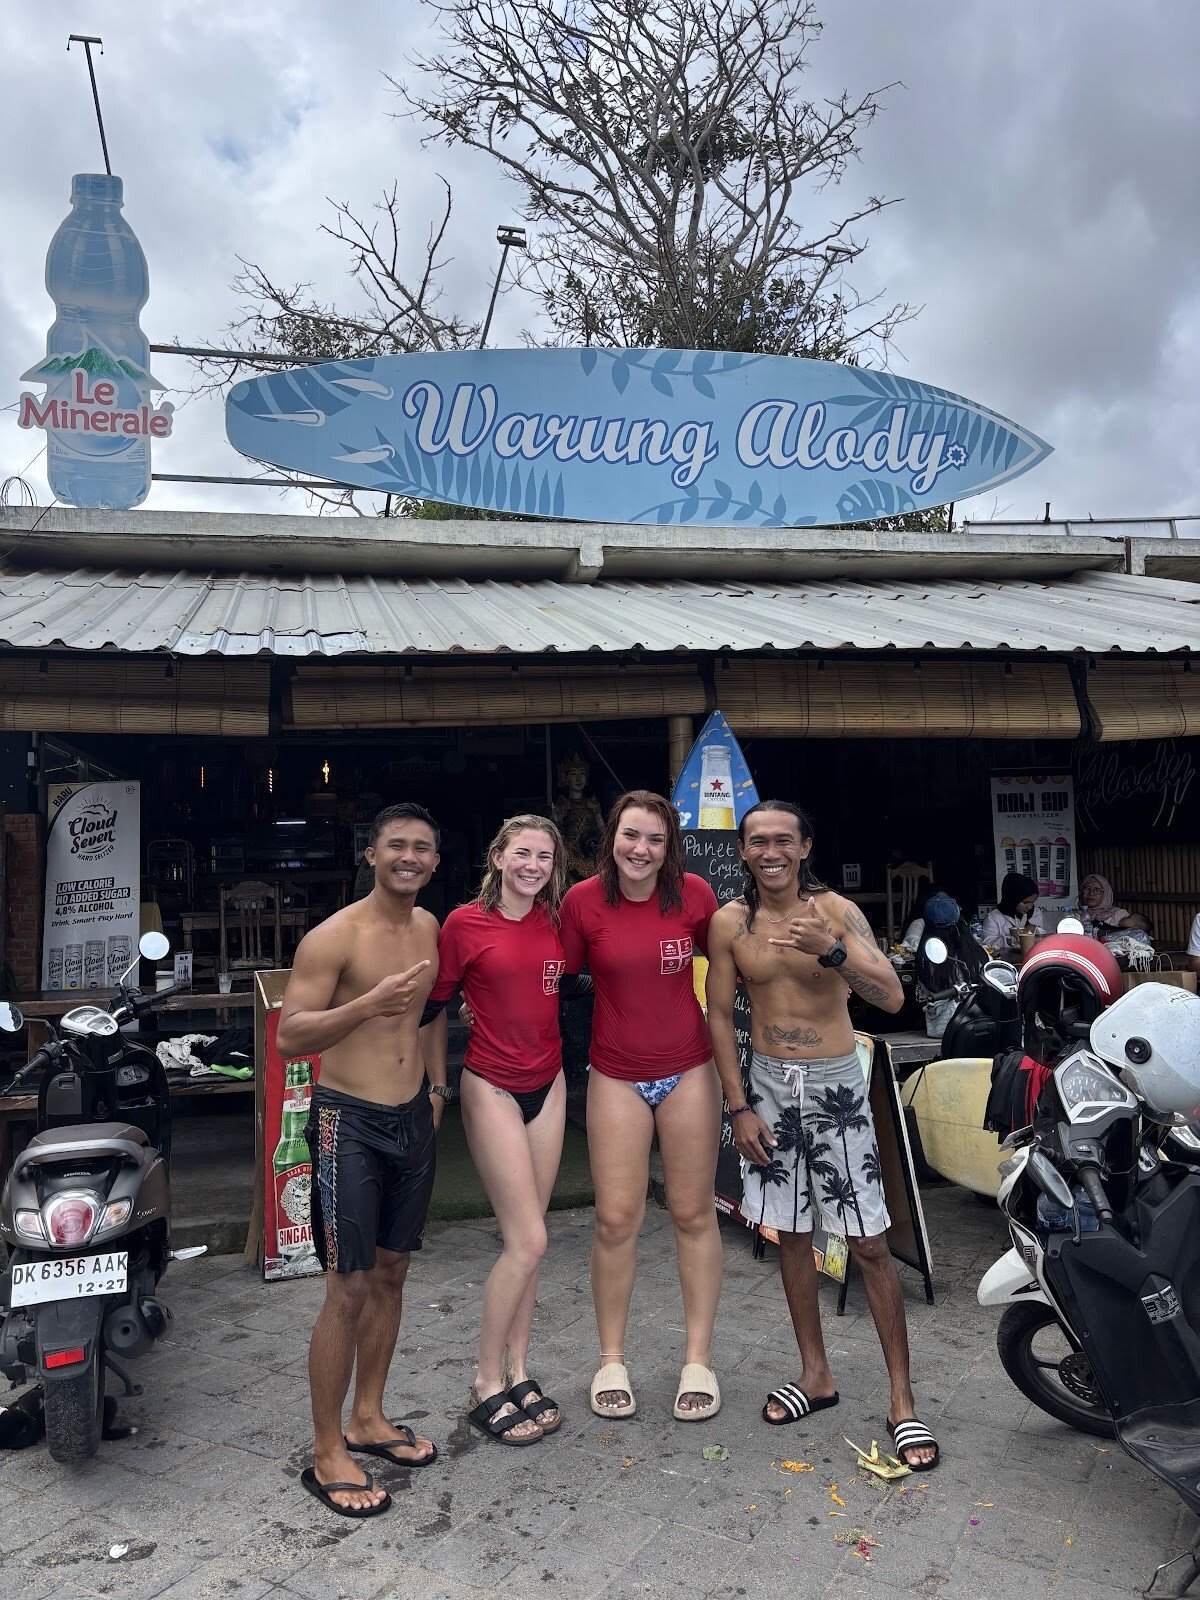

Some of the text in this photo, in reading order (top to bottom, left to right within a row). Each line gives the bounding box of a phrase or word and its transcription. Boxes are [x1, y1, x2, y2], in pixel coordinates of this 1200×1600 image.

[75, 370, 115, 406] Le
[22, 396, 170, 437] Minerale
[403, 379, 949, 495] Warung Alody
[53, 786, 73, 807] BARU
[68, 810, 118, 836] Cloud
[71, 830, 115, 853] Seven
[77, 845, 115, 862] HARD SELTZER
[58, 878, 113, 893] LOW CALORIE
[56, 888, 129, 905] NO ADDED SUGAR
[55, 901, 114, 916] 4,8% ALCOHOL
[115, 911, 134, 920] Hard
[280, 1226, 312, 1247] SINGAR
[13, 1253, 128, 1285] DK 6356 AAK
